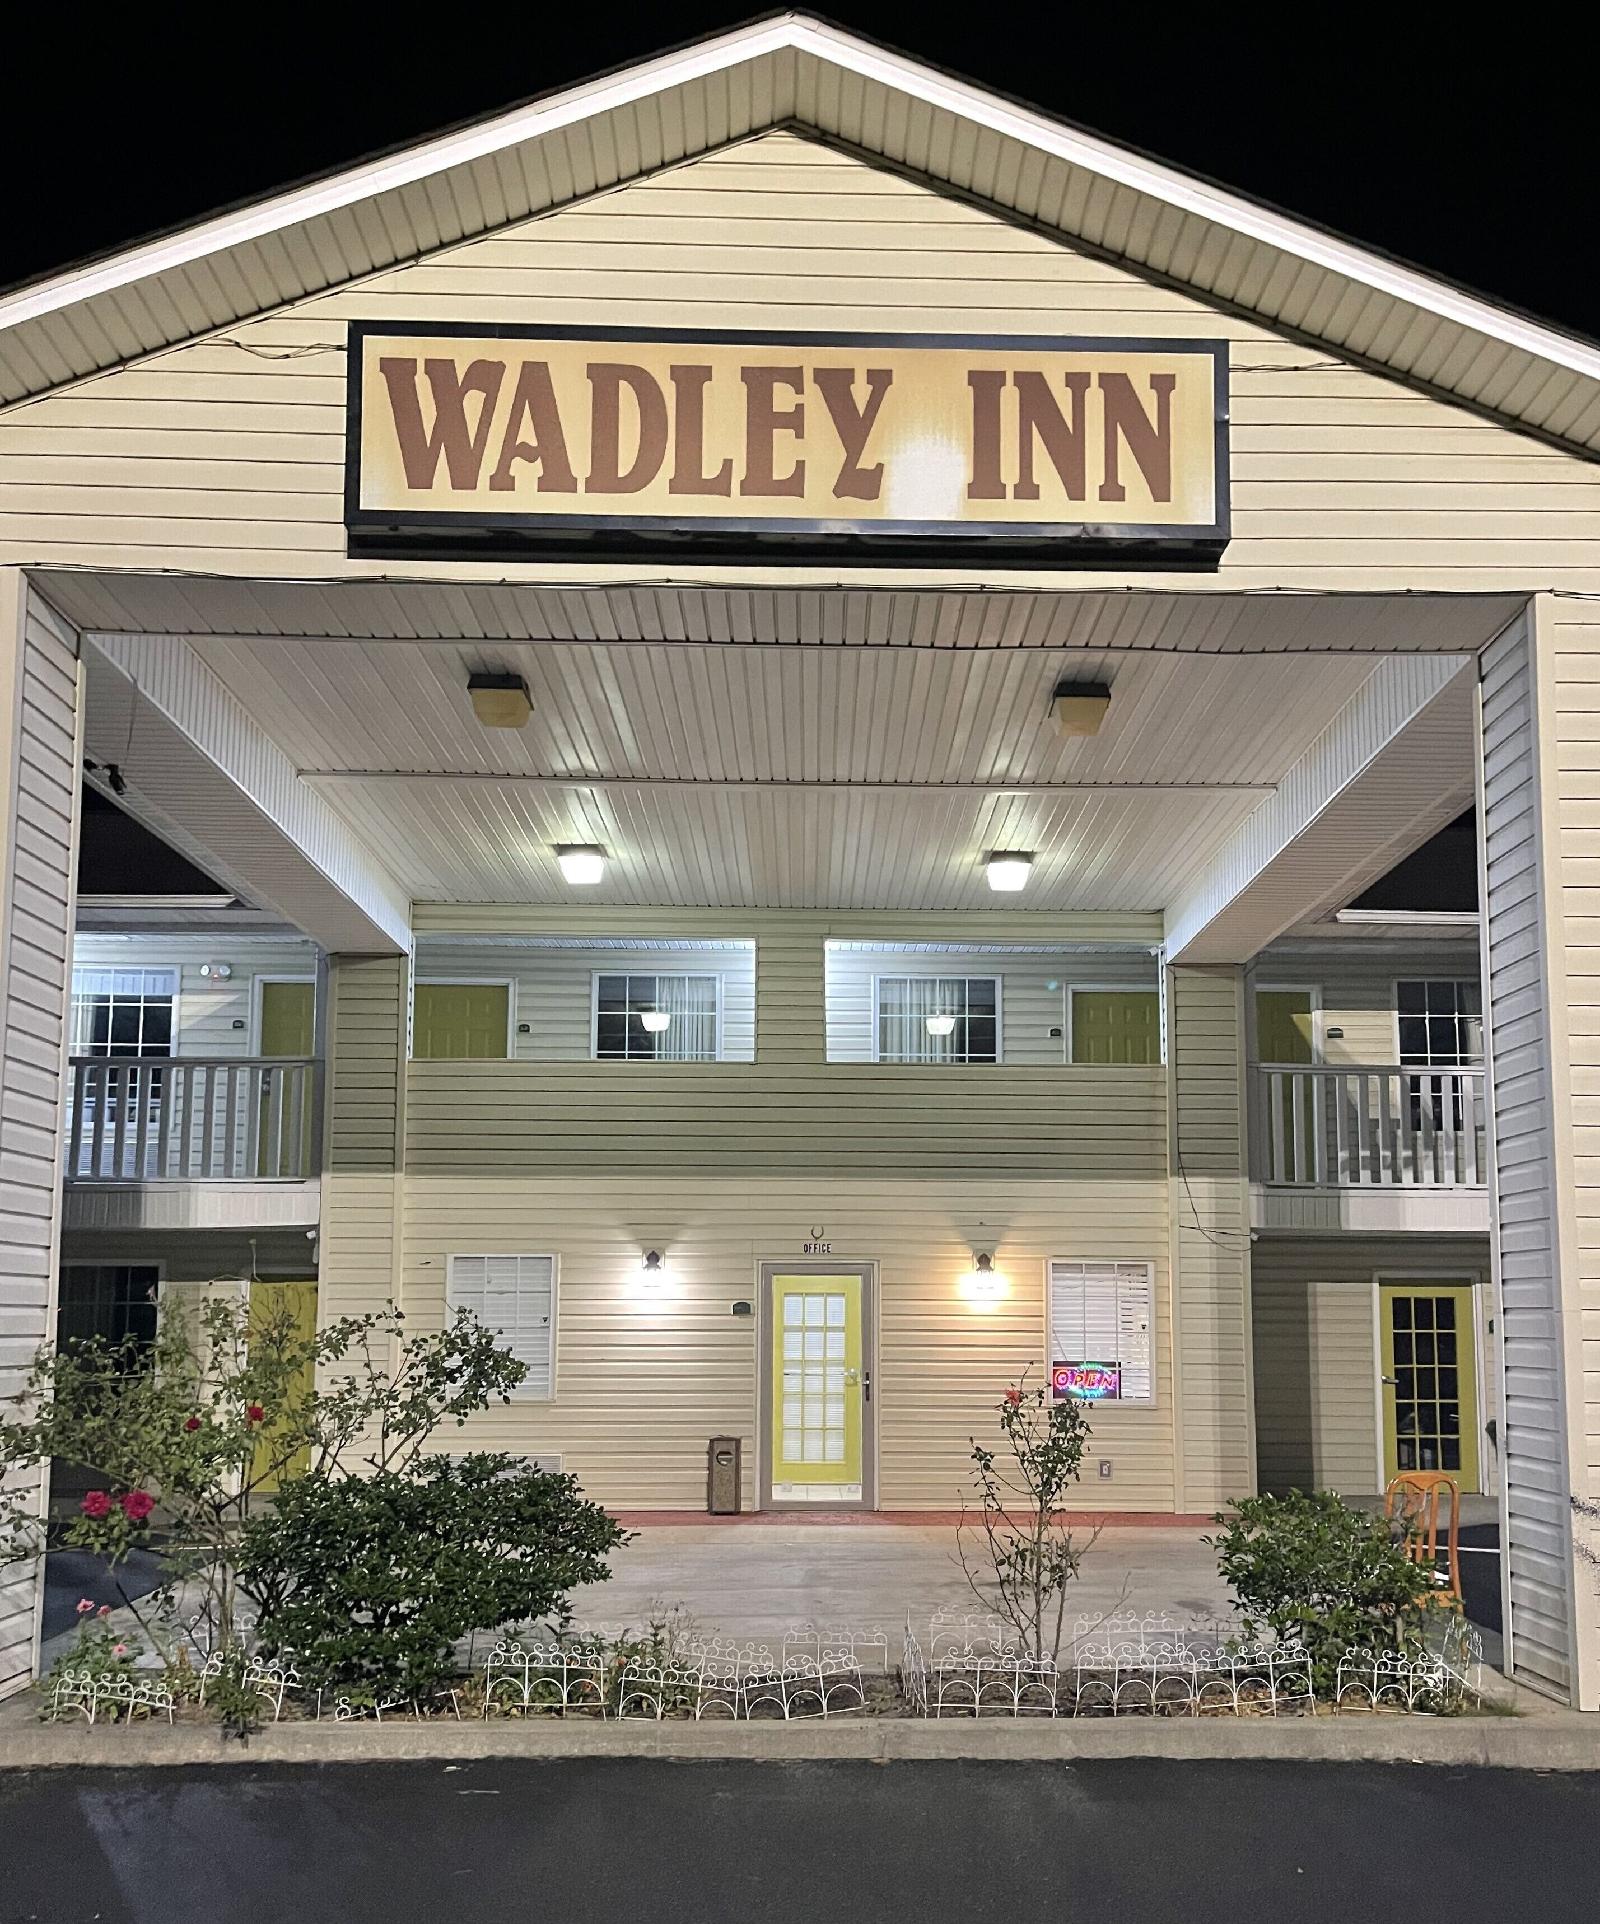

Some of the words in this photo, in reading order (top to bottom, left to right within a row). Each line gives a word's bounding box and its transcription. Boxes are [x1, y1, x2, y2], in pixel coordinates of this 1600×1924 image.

[379, 357, 894, 500] WADLEY
[967, 370, 1176, 502] INN
[803, 1243, 832, 1253] OFFICE
[1055, 1369, 1118, 1390] OPEN
